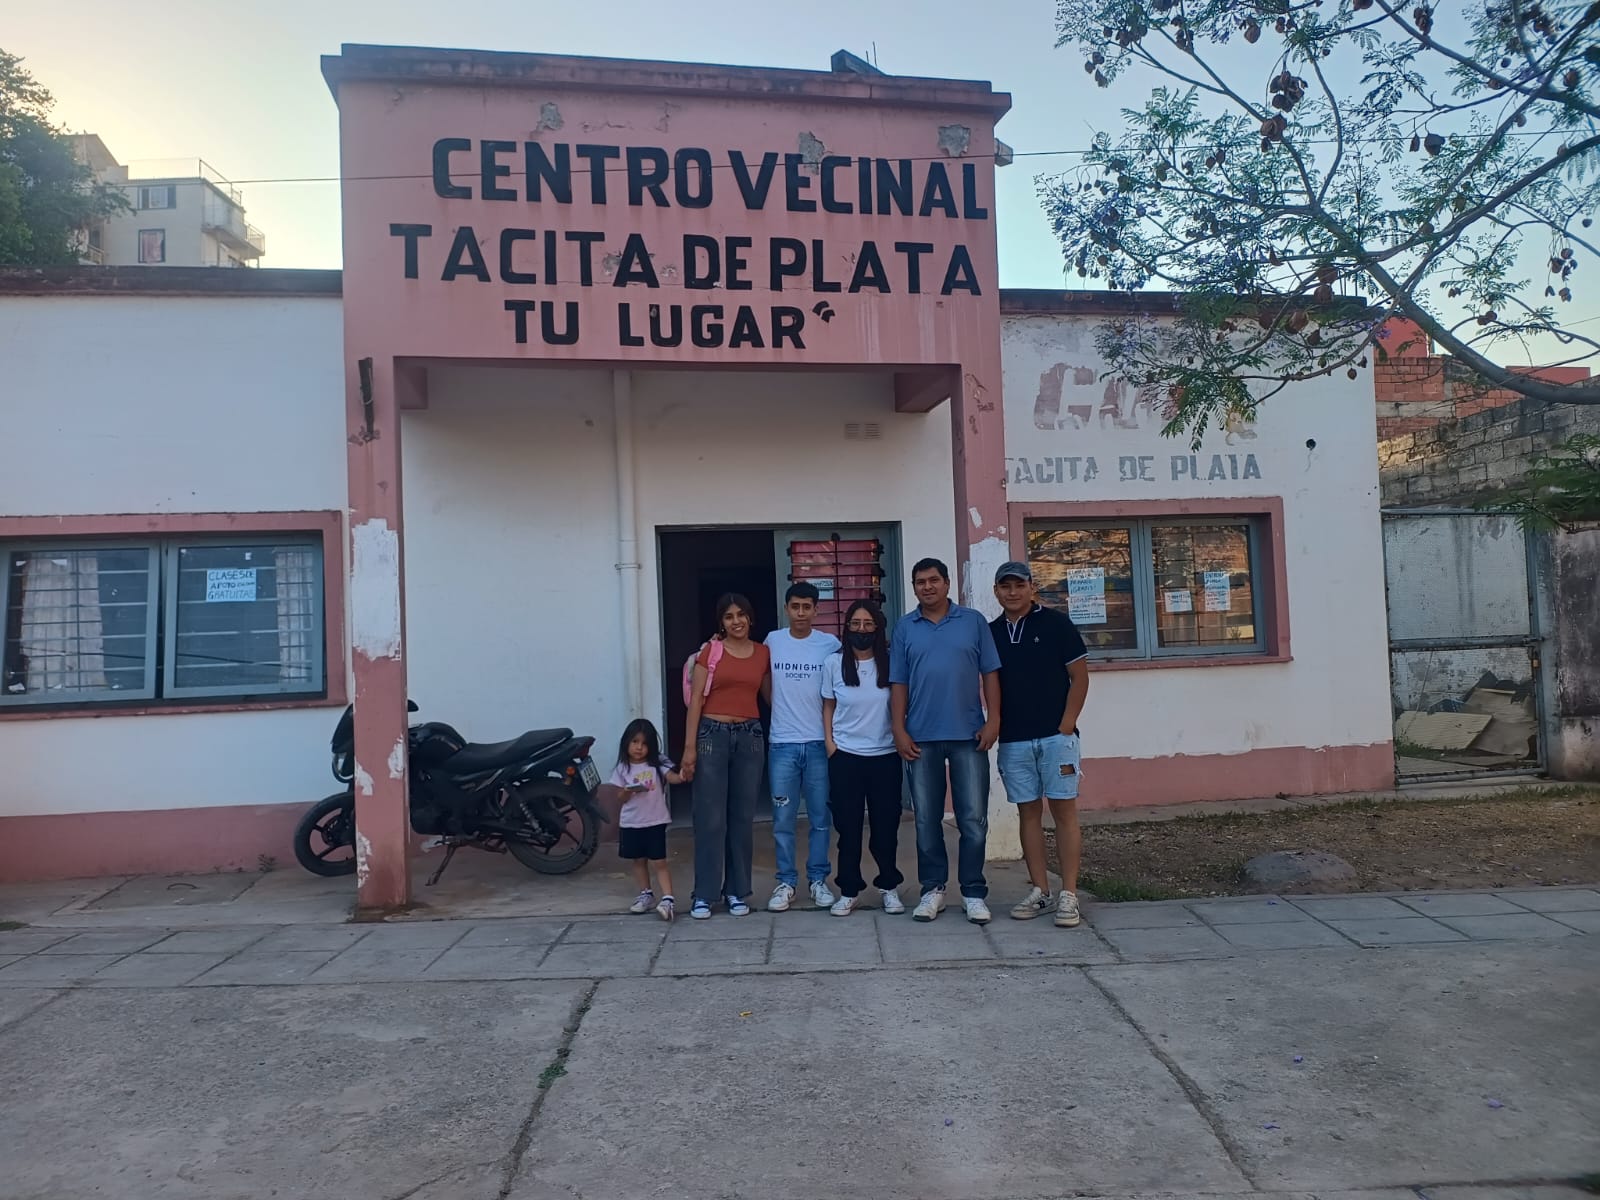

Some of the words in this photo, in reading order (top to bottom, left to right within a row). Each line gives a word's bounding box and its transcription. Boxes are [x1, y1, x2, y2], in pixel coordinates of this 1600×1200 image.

[432, 138, 713, 209] CENTRO
[728, 150, 988, 220] VECINAL
[389, 223, 660, 288] TACITA
[683, 234, 753, 290] DE
[770, 237, 982, 296] PLATA
[504, 299, 579, 345] TU
[1118, 455, 1155, 482] DE
[208, 571, 245, 581] CLASES
[774, 662, 823, 672] MIDNIGHT
